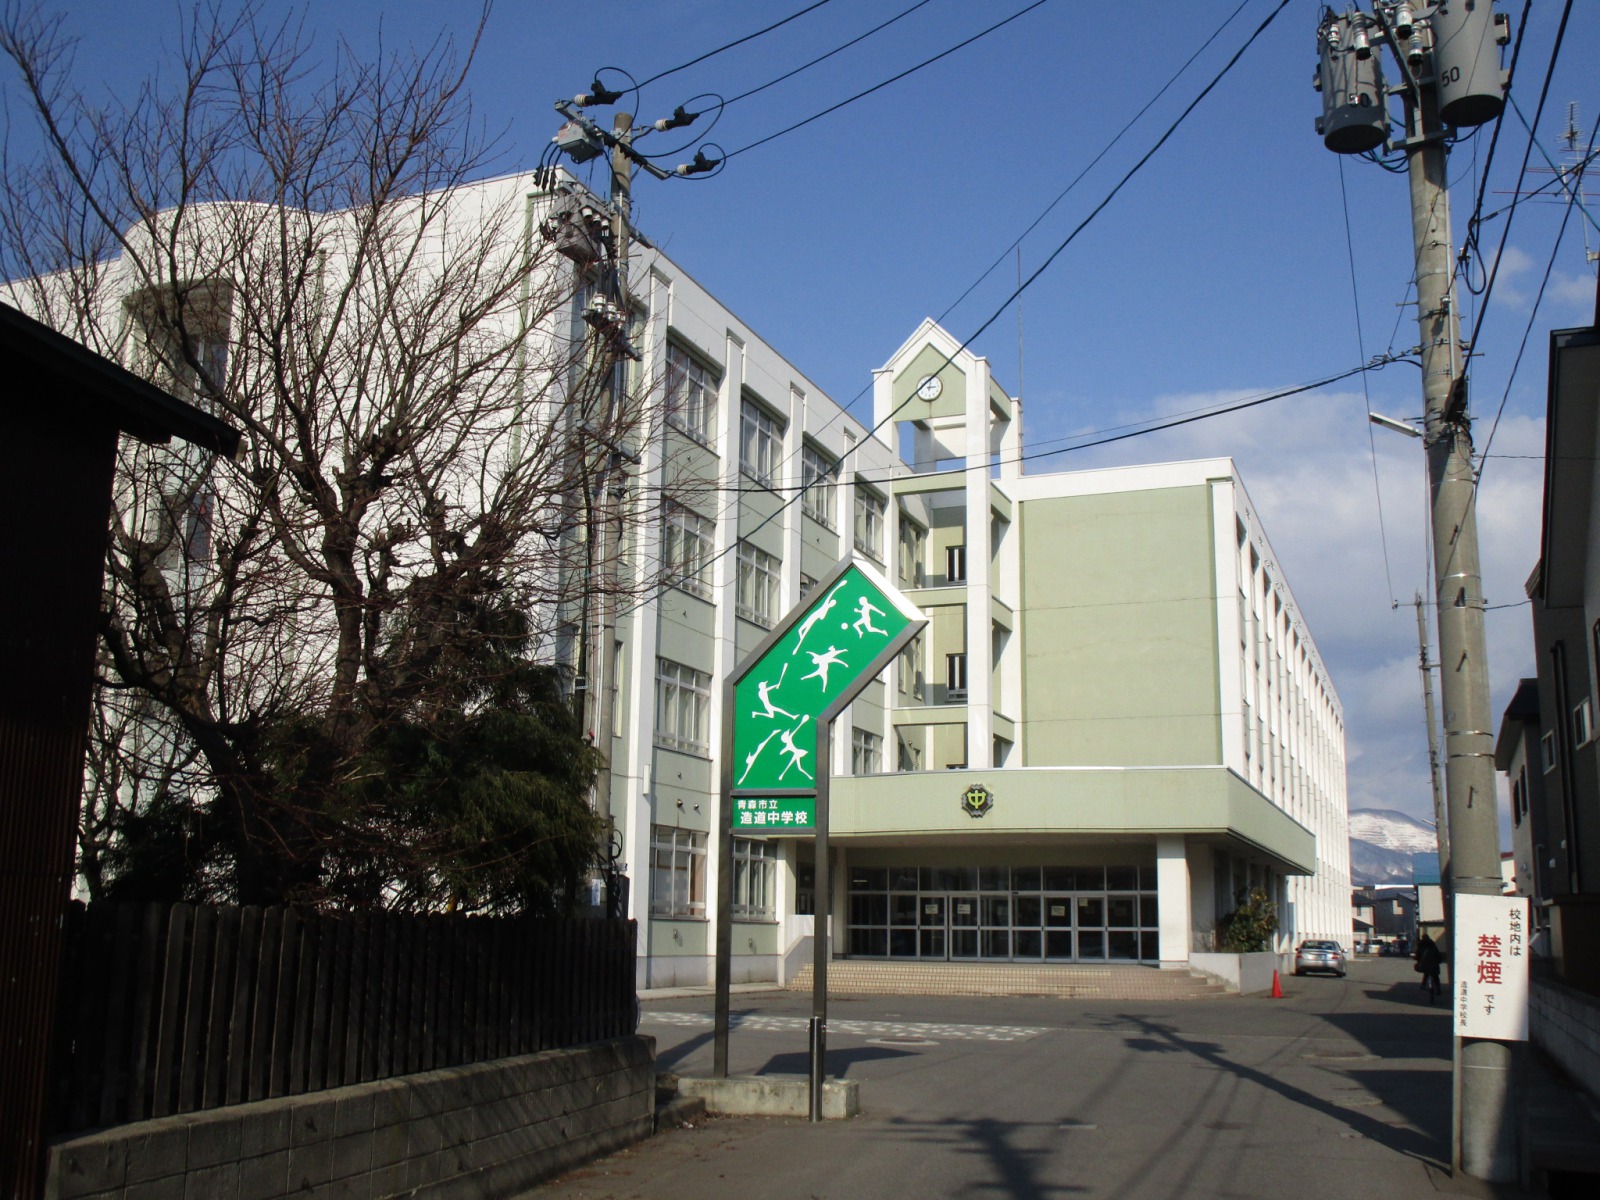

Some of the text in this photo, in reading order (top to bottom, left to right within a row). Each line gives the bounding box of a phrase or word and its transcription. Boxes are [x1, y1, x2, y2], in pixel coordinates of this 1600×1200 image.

[1442, 66, 1460, 88] 50
[738, 799, 778, 810] 青森市立
[740, 810, 808, 825] 造道中学校
[1509, 908, 1522, 957] 校地内は
[1477, 933, 1503, 985] 禁煙
